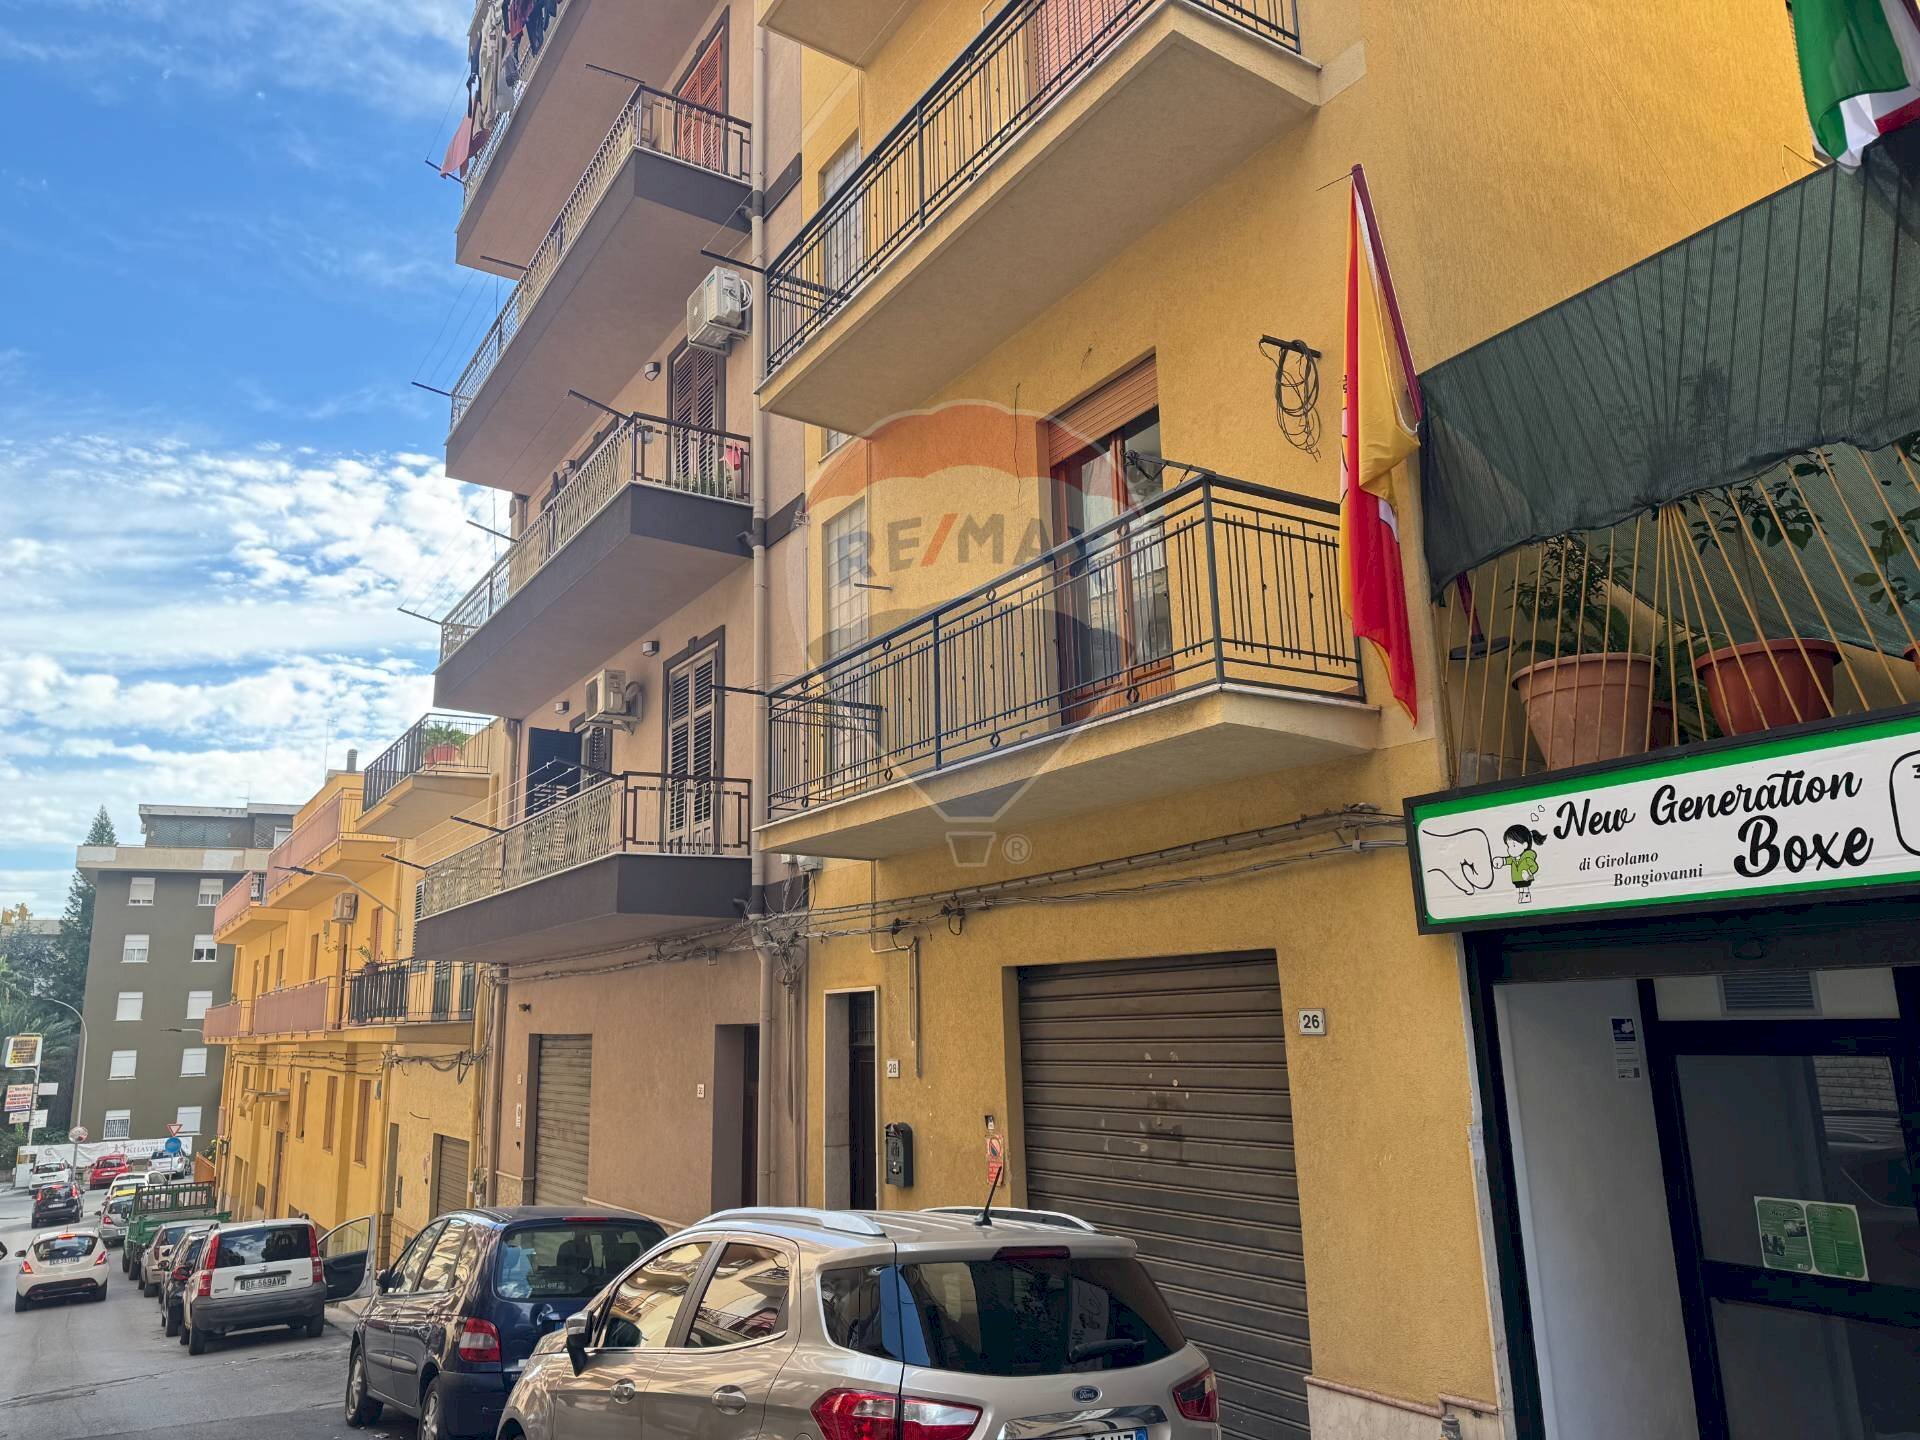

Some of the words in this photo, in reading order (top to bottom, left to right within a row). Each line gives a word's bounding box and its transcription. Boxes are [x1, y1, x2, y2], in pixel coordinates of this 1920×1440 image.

[1553, 798, 1636, 840] New
[1650, 770, 1863, 826] Generation
[1733, 814, 1875, 878] Boxe
[1578, 857, 1591, 872] di
[1595, 852, 1659, 869] Girolamo
[1613, 863, 1703, 887] Bongiovanni
[1302, 1014, 1320, 1029] 26
[888, 1063, 897, 1074] 28
[1079, 1389, 1095, 1399] Ford
